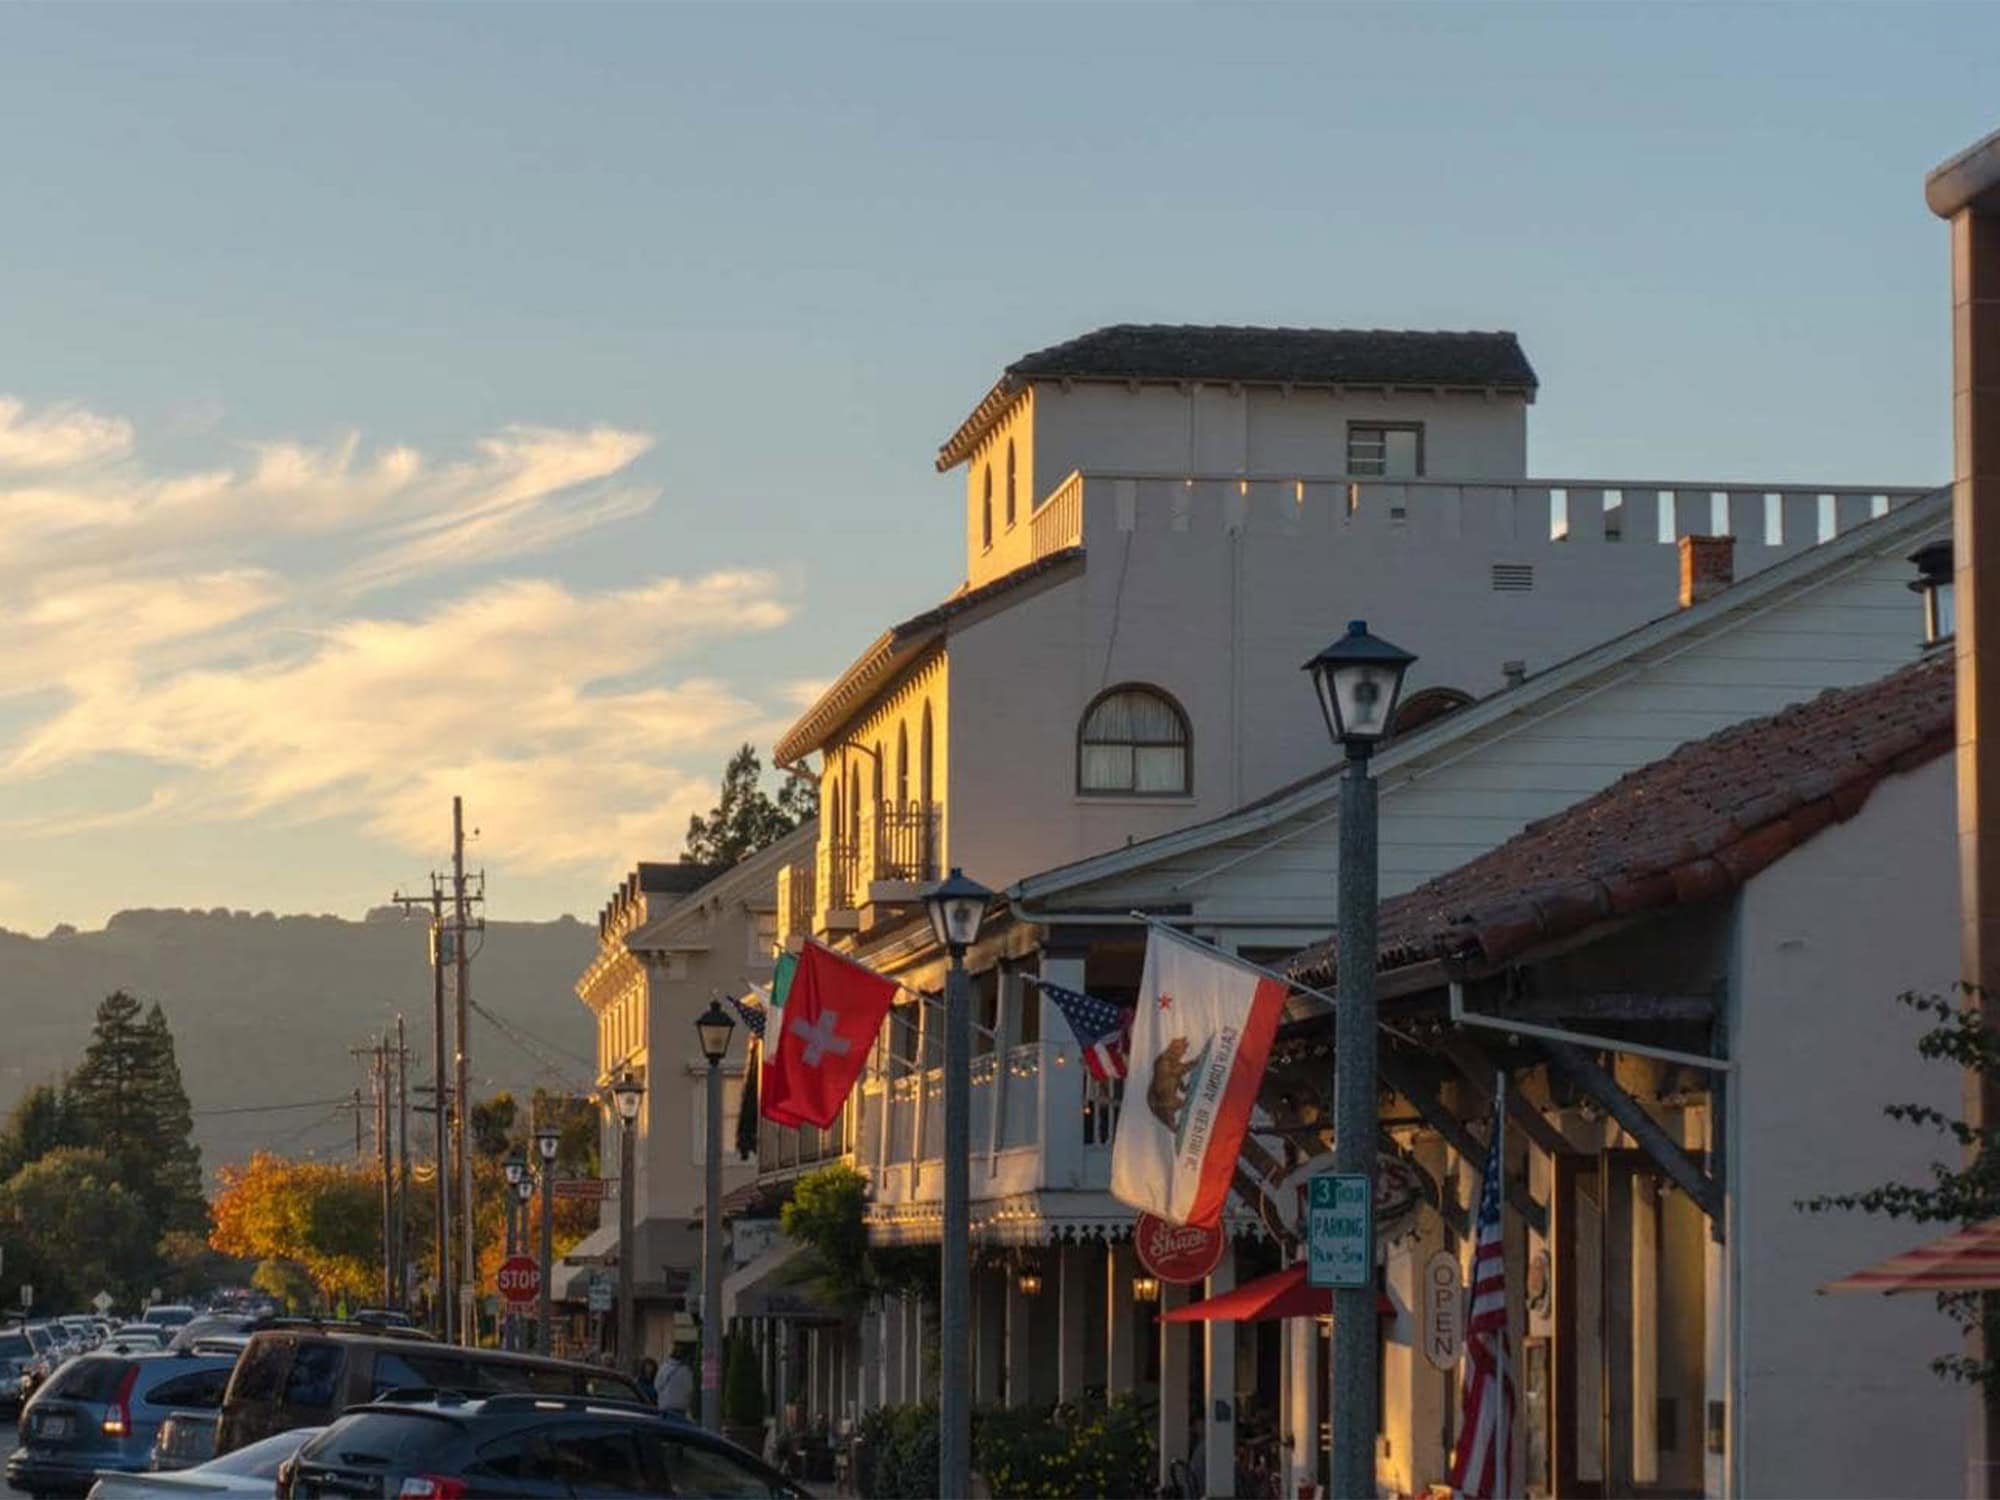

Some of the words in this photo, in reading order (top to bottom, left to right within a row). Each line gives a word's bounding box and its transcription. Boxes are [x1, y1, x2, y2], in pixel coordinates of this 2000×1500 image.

[1317, 1179, 1330, 1203] 3
[1314, 1215, 1364, 1238] PARKING
[499, 1269, 542, 1289] STOP
[1434, 1265, 1454, 1356] OPEN
